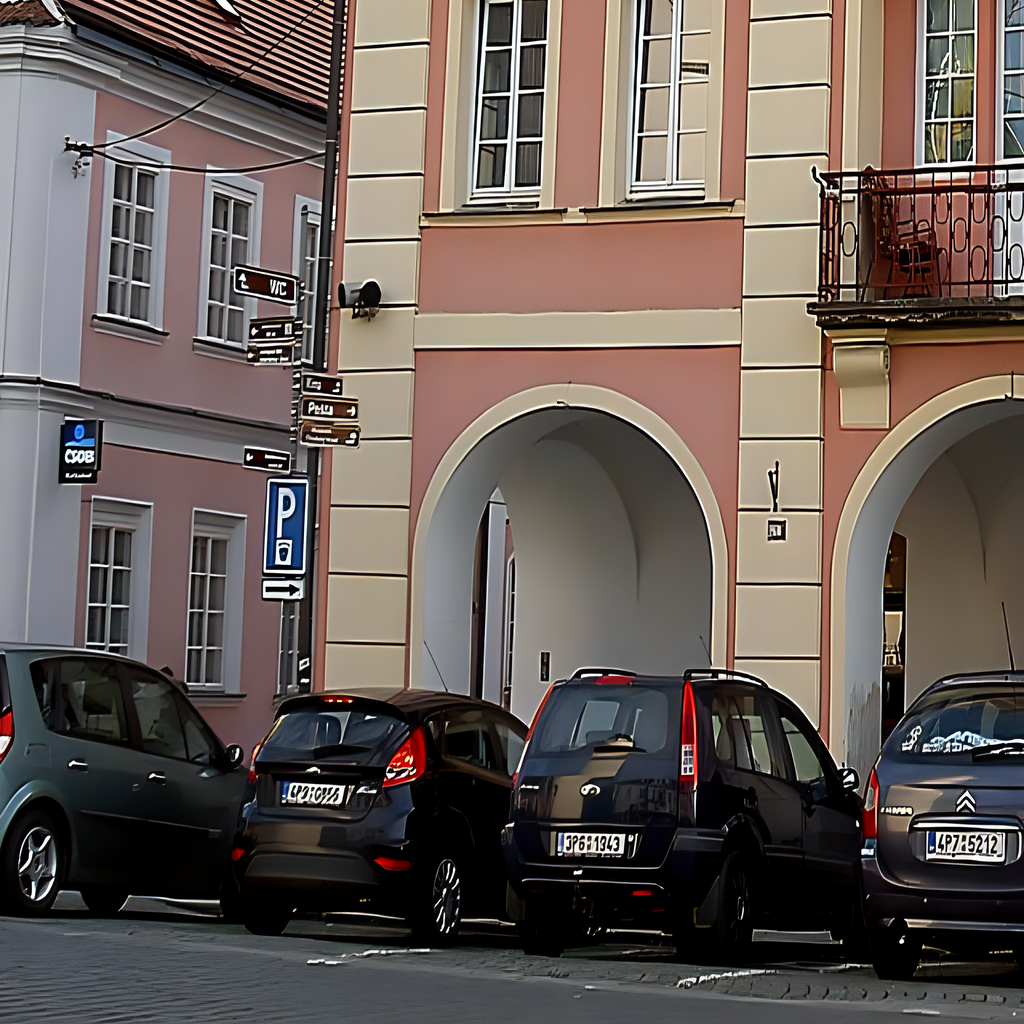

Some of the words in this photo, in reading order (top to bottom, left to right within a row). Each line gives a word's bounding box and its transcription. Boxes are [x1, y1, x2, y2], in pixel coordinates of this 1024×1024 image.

[276, 487, 296, 538] P
[937, 834, 960, 853] 4P7
[967, 834, 998, 854] 5212
